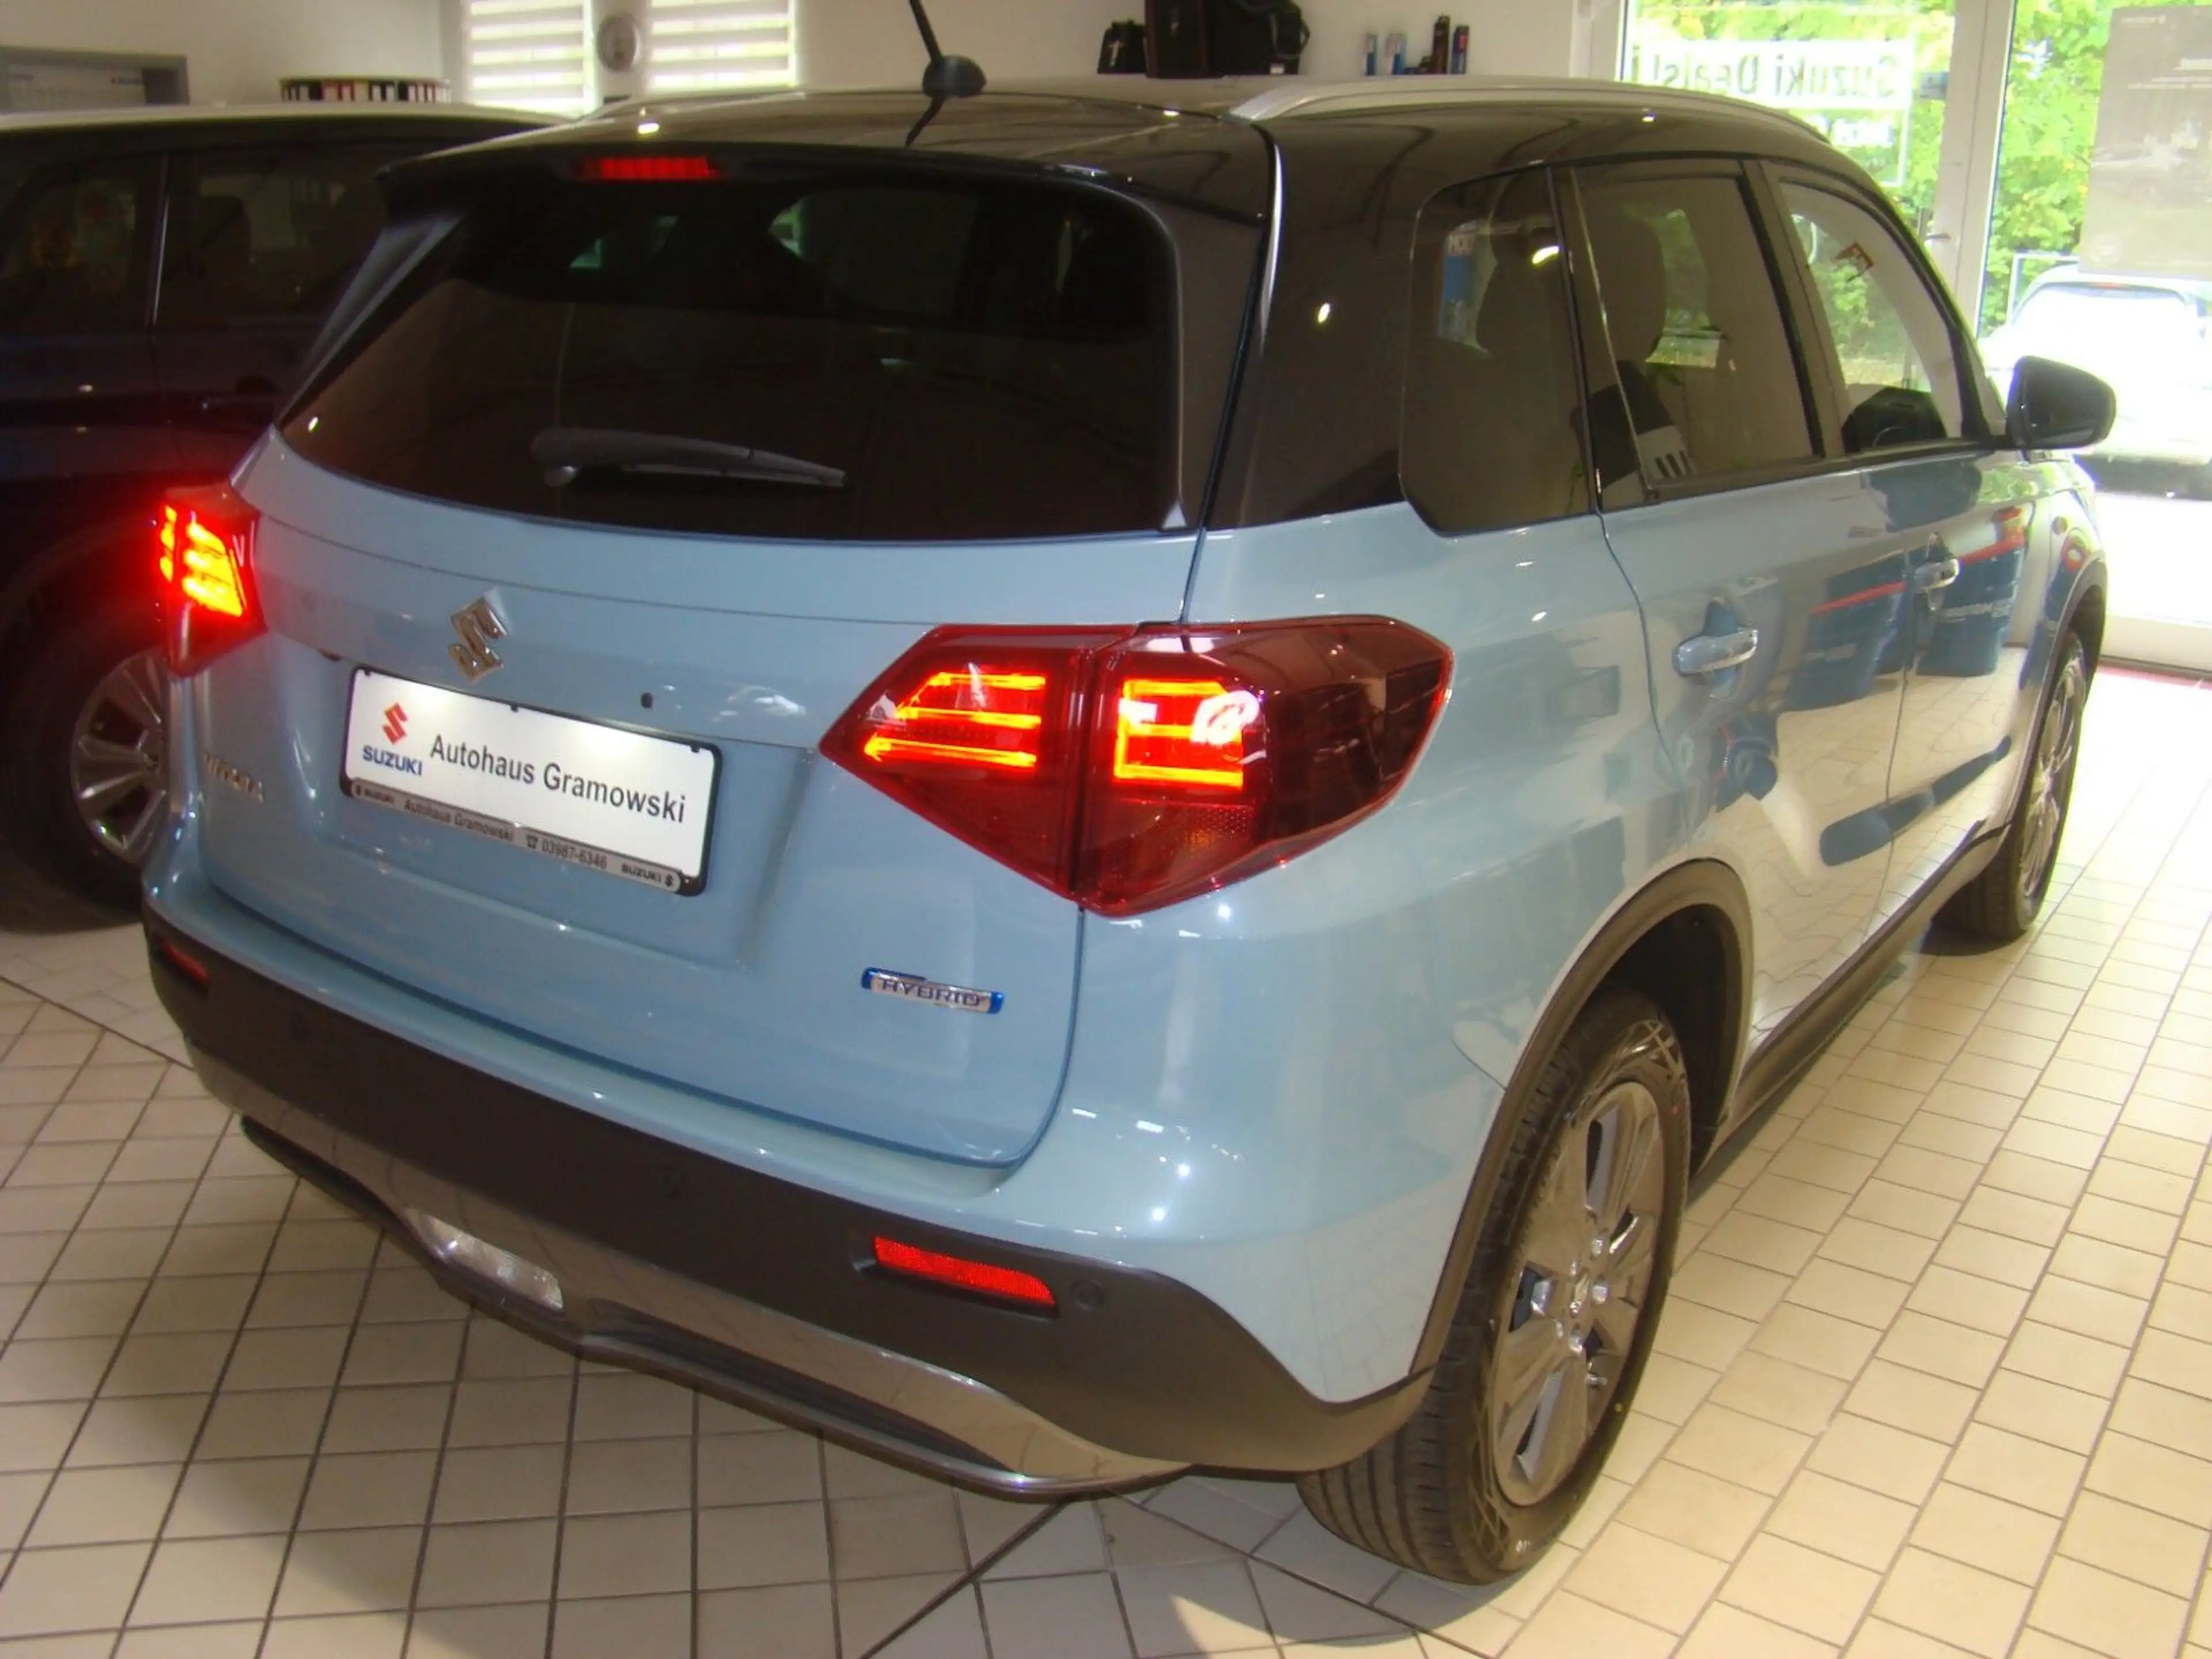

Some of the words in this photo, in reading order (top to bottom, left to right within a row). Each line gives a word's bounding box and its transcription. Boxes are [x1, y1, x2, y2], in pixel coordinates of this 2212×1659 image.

[362, 745, 422, 775] SUZUKI
[430, 734, 535, 784] Autohaus
[543, 762, 686, 823] Gramowski
[405, 799, 451, 824] Autohaus
[881, 978, 981, 1007] HYBRID
